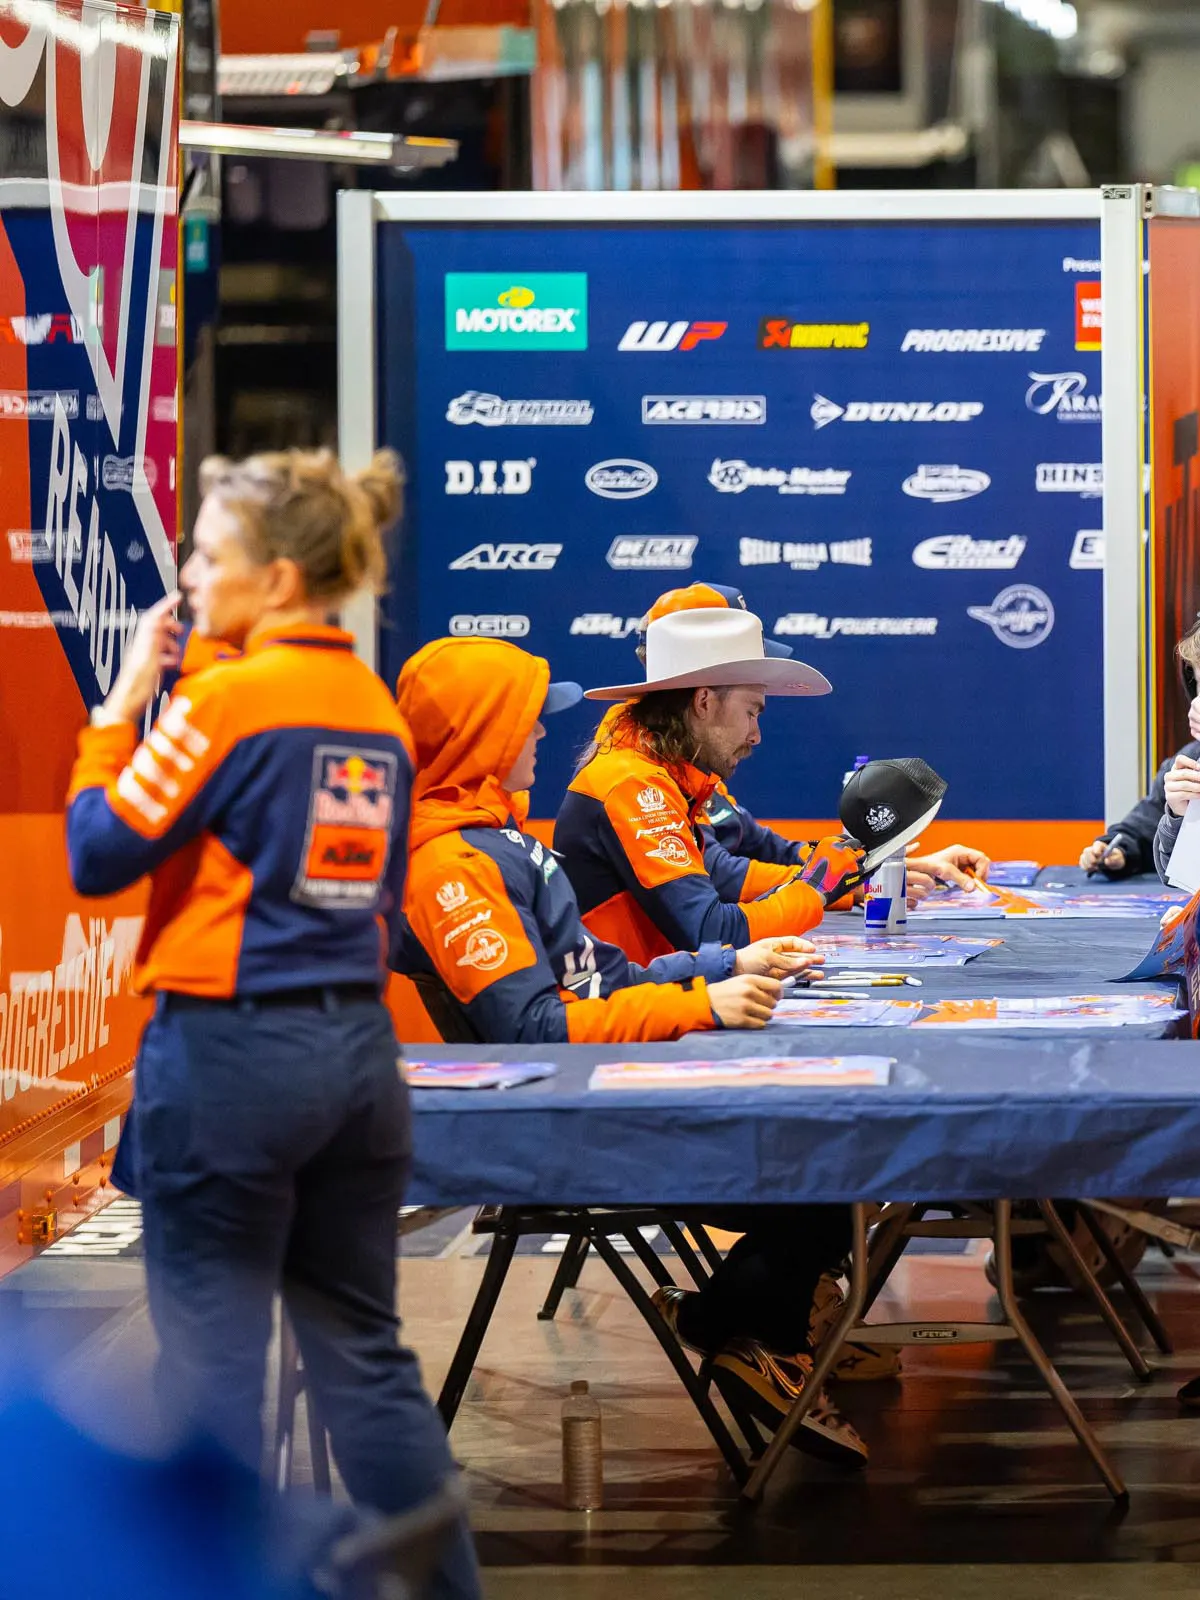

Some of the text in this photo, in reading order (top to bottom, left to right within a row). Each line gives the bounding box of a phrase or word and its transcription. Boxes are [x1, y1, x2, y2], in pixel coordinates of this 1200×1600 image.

[456, 308, 577, 333] MOTOREX
[901, 330, 1046, 352] PROGRESSIVE
[842, 403, 984, 422] DUNLOP
[445, 461, 533, 494] D.I.D
